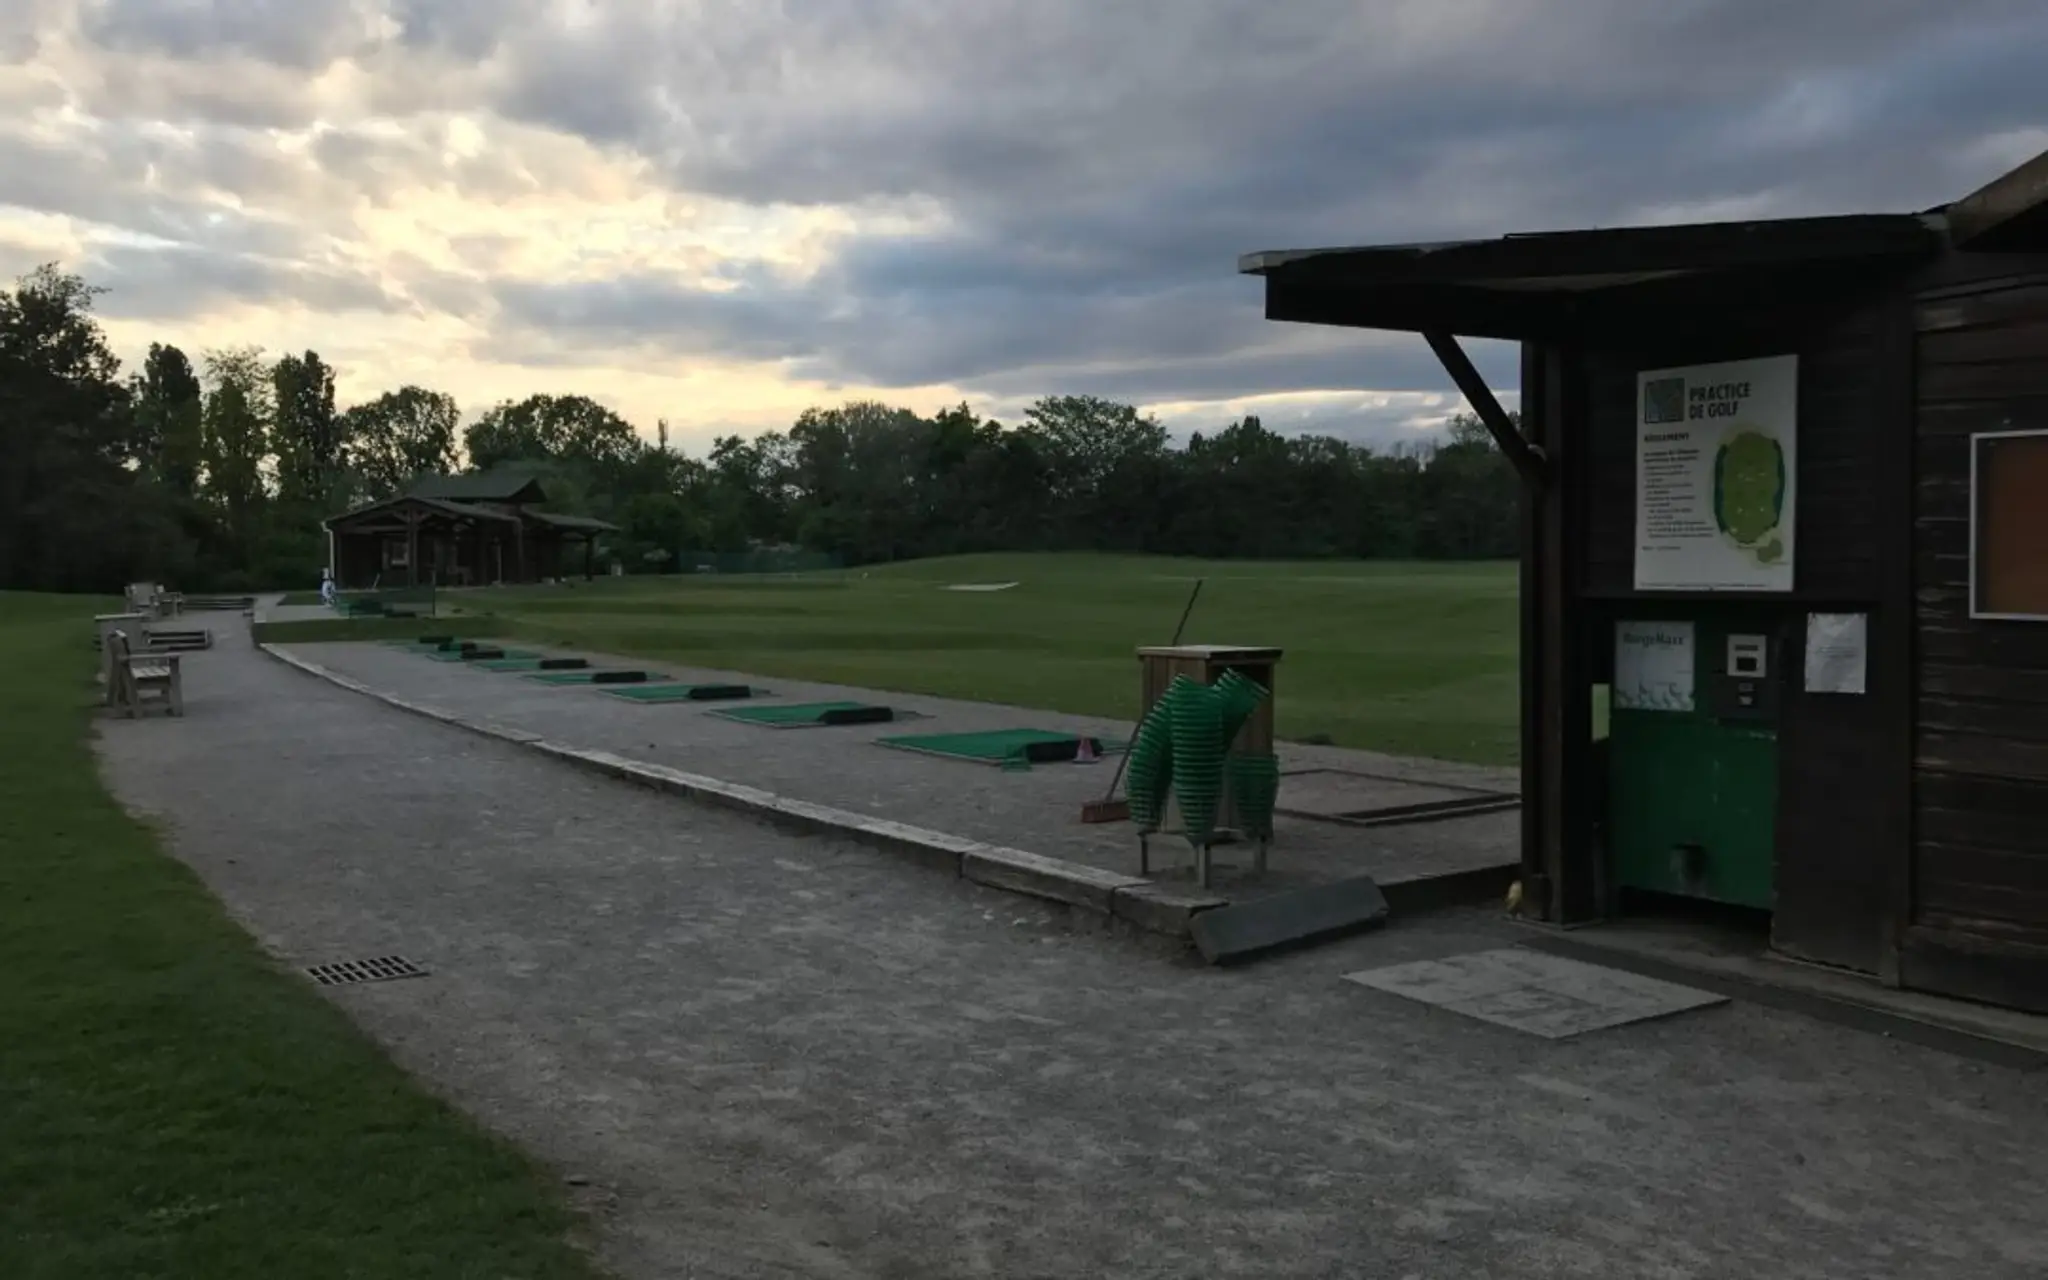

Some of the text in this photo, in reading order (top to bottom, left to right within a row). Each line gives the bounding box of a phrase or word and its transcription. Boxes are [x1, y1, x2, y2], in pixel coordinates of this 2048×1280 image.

[1690, 382, 1751, 401] PRACTICE
[1690, 401, 1738, 419] DE GOLF
